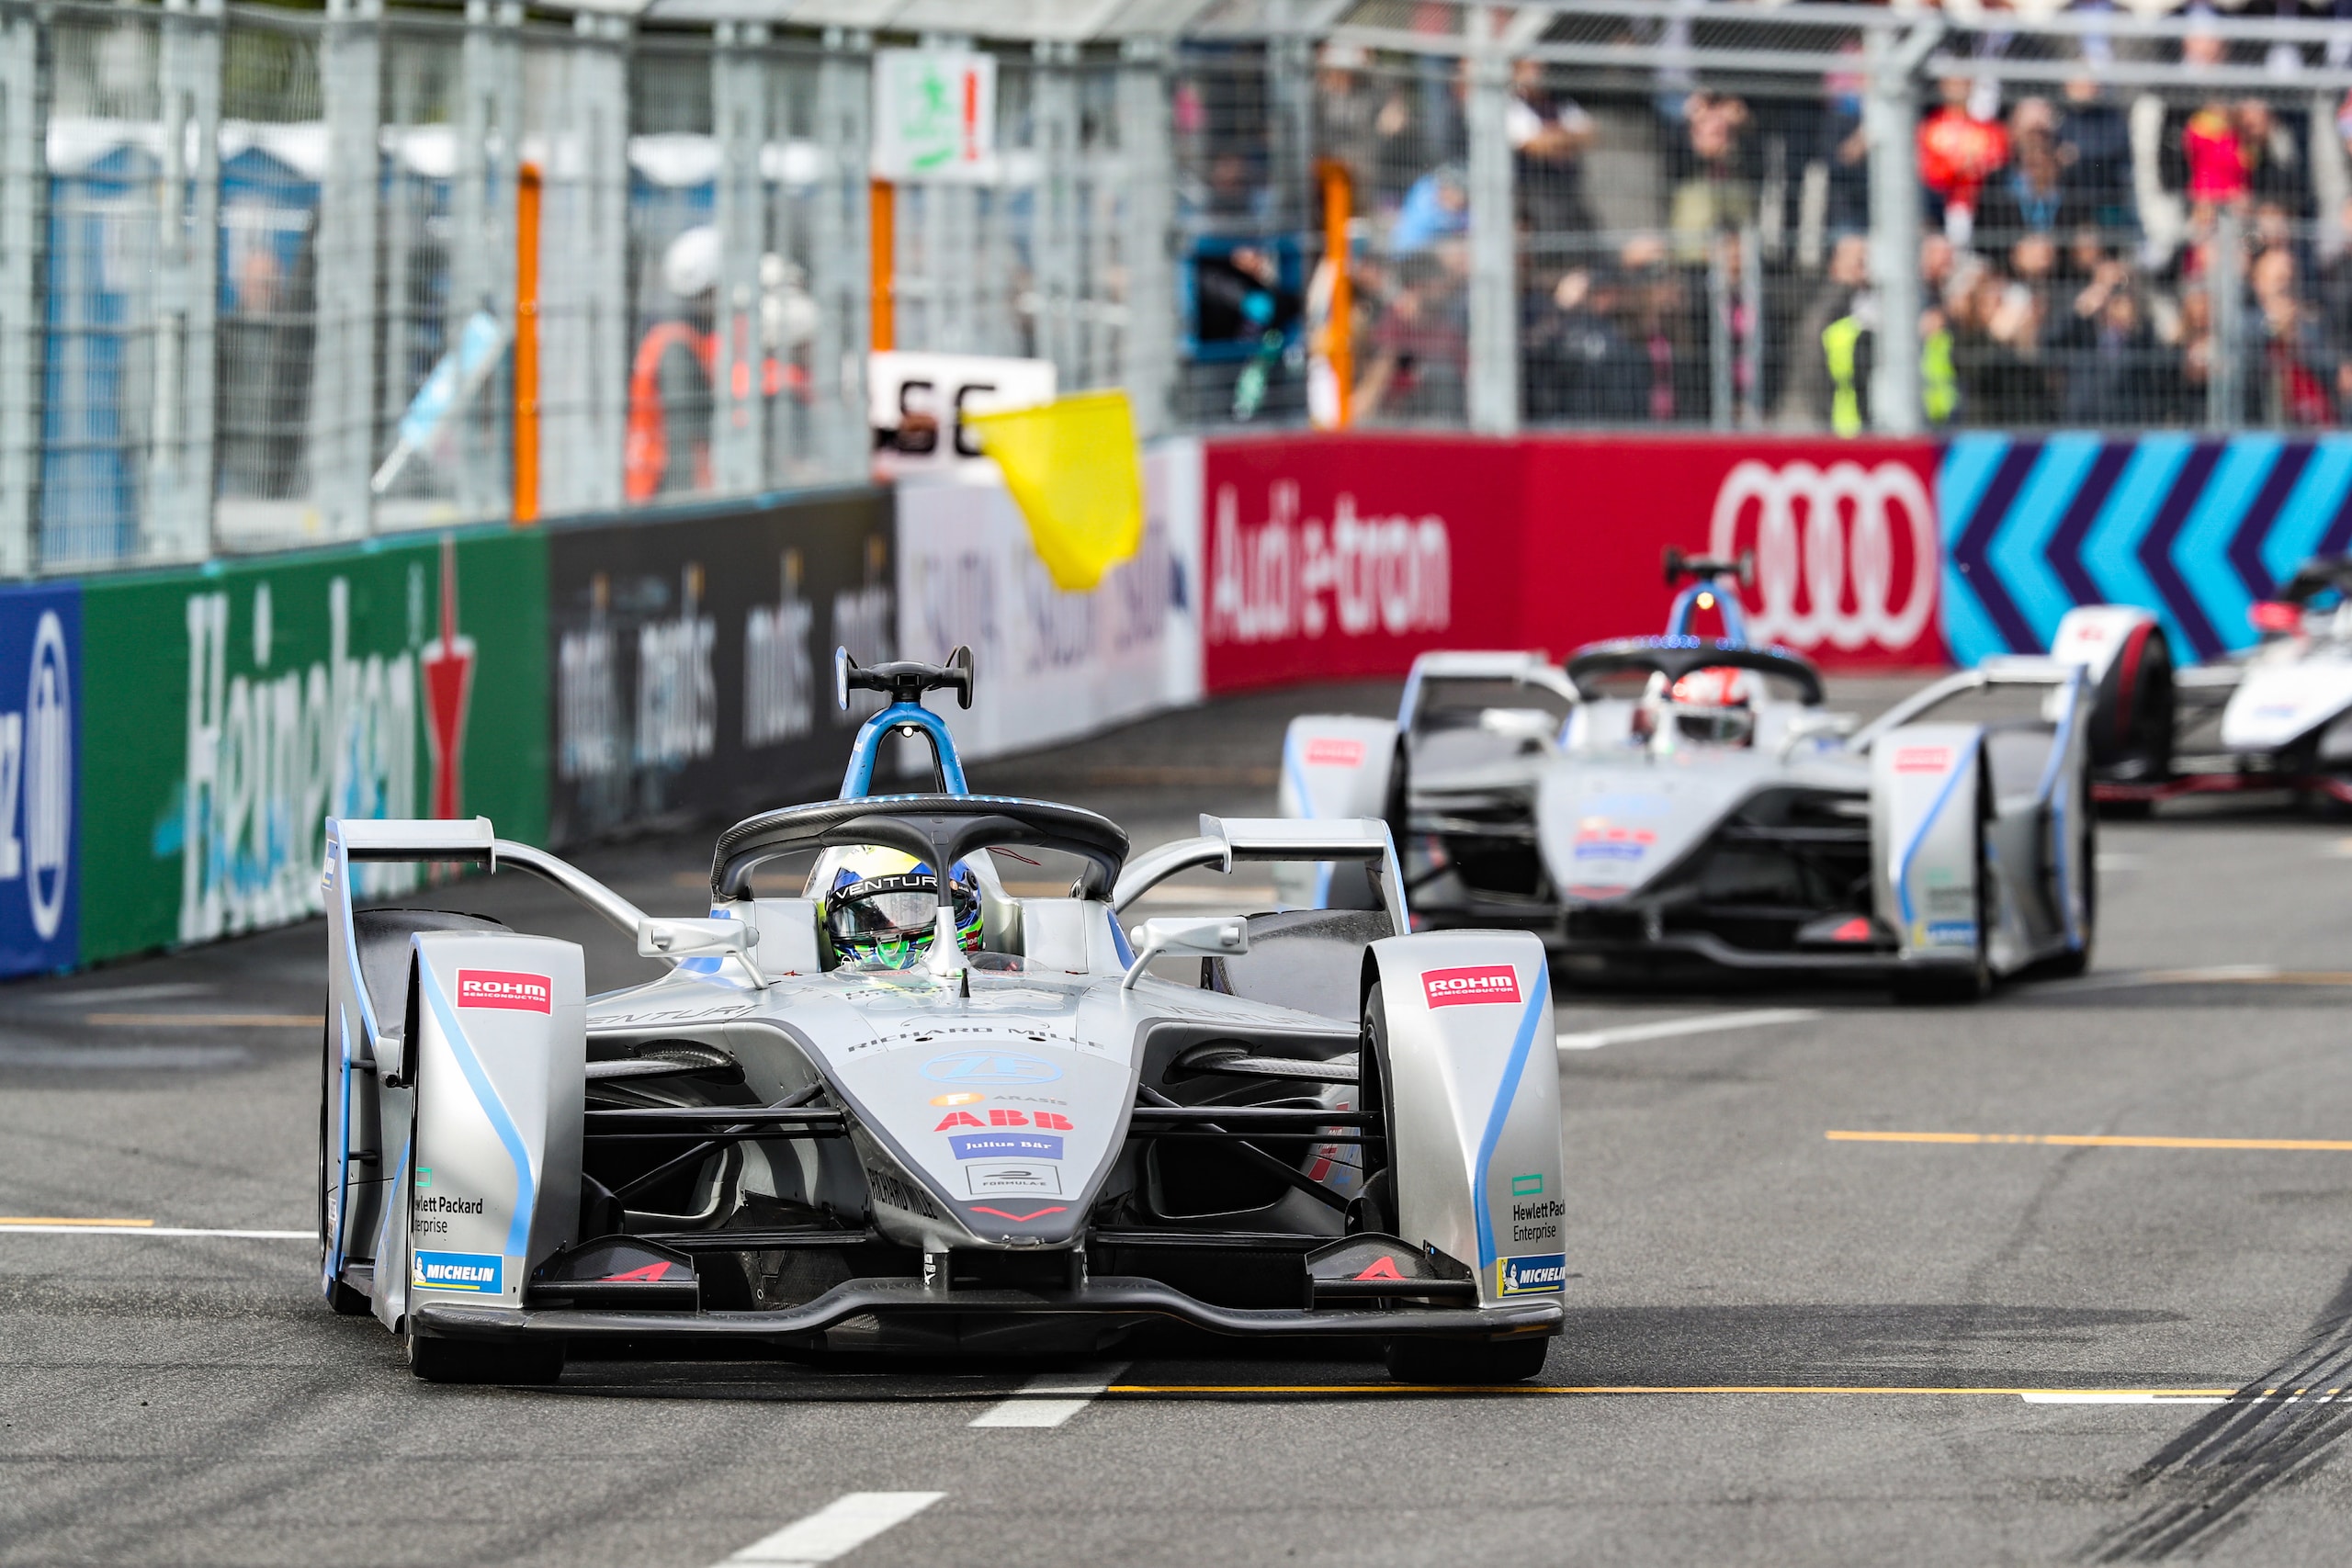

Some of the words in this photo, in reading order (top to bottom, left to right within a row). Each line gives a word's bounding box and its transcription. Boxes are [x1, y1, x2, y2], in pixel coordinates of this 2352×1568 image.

[835, 875, 938, 899] VENTUR
[462, 980, 547, 998] ROHM
[1428, 976, 1513, 993] ROHM
[1430, 987, 1514, 998] SEMICONDUCTOR
[462, 991, 547, 1003] SEMICONDUCTOR
[586, 1003, 764, 1024] ENTURI
[847, 1027, 993, 1053] RICHARD
[1008, 1027, 1105, 1050] MILLE
[933, 1109, 1075, 1133] ABB
[966, 1141, 1015, 1150] Julius
[438, 1196, 483, 1214] Packard
[1513, 1201, 1549, 1222] Hewlett
[1513, 1222, 1556, 1243] Enterprise
[426, 1264, 495, 1282] MICHELIN
